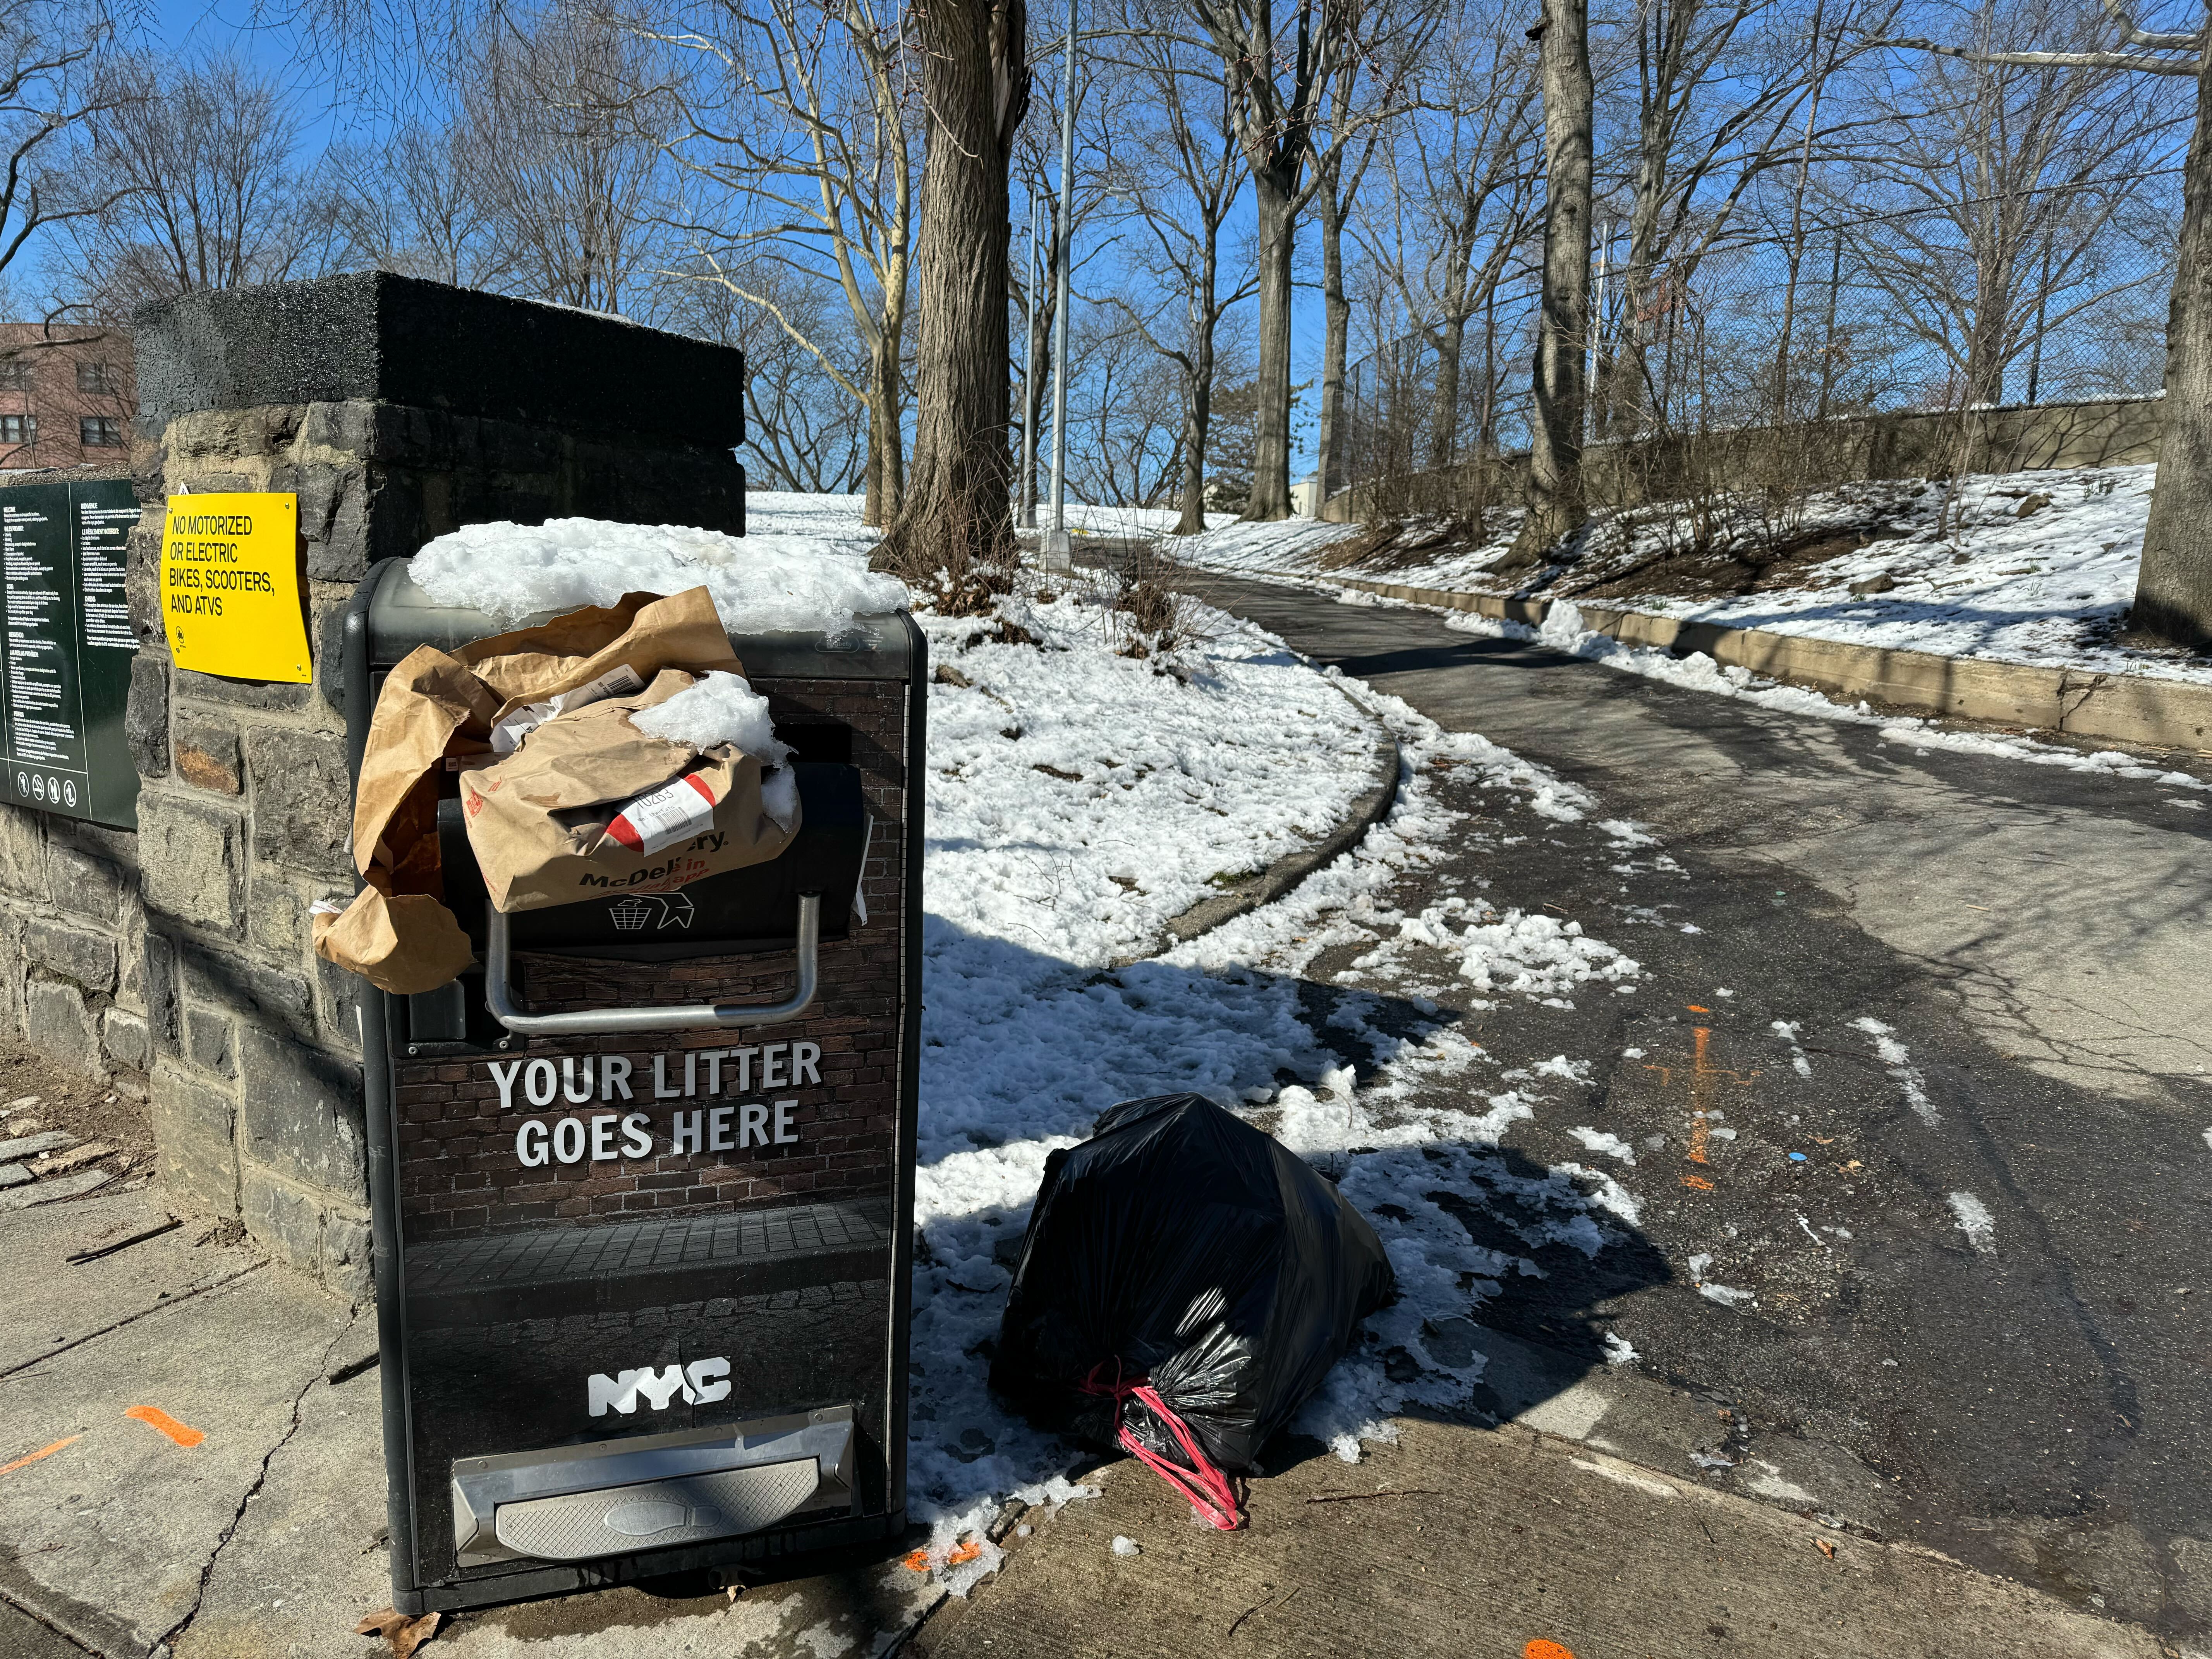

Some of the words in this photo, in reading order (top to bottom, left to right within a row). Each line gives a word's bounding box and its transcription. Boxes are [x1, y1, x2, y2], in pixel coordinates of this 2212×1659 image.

[172, 516, 185, 535] NO
[188, 515, 252, 535] MOTORIZED
[170, 542, 183, 561] OR
[186, 542, 238, 563] ELECTRIC
[170, 568, 203, 592] BIKES,
[206, 569, 275, 596] SCOOTERS,
[172, 594, 192, 613] AND
[195, 596, 223, 616] ATVS
[673, 868, 710, 884] app
[686, 859, 706, 871] in
[488, 1055, 634, 1109] YOUR
[654, 1042, 821, 1098] LITTER
[516, 1113, 653, 1167] GOES
[673, 1100, 799, 1155] HERE
[588, 1357, 731, 1417] NYC
